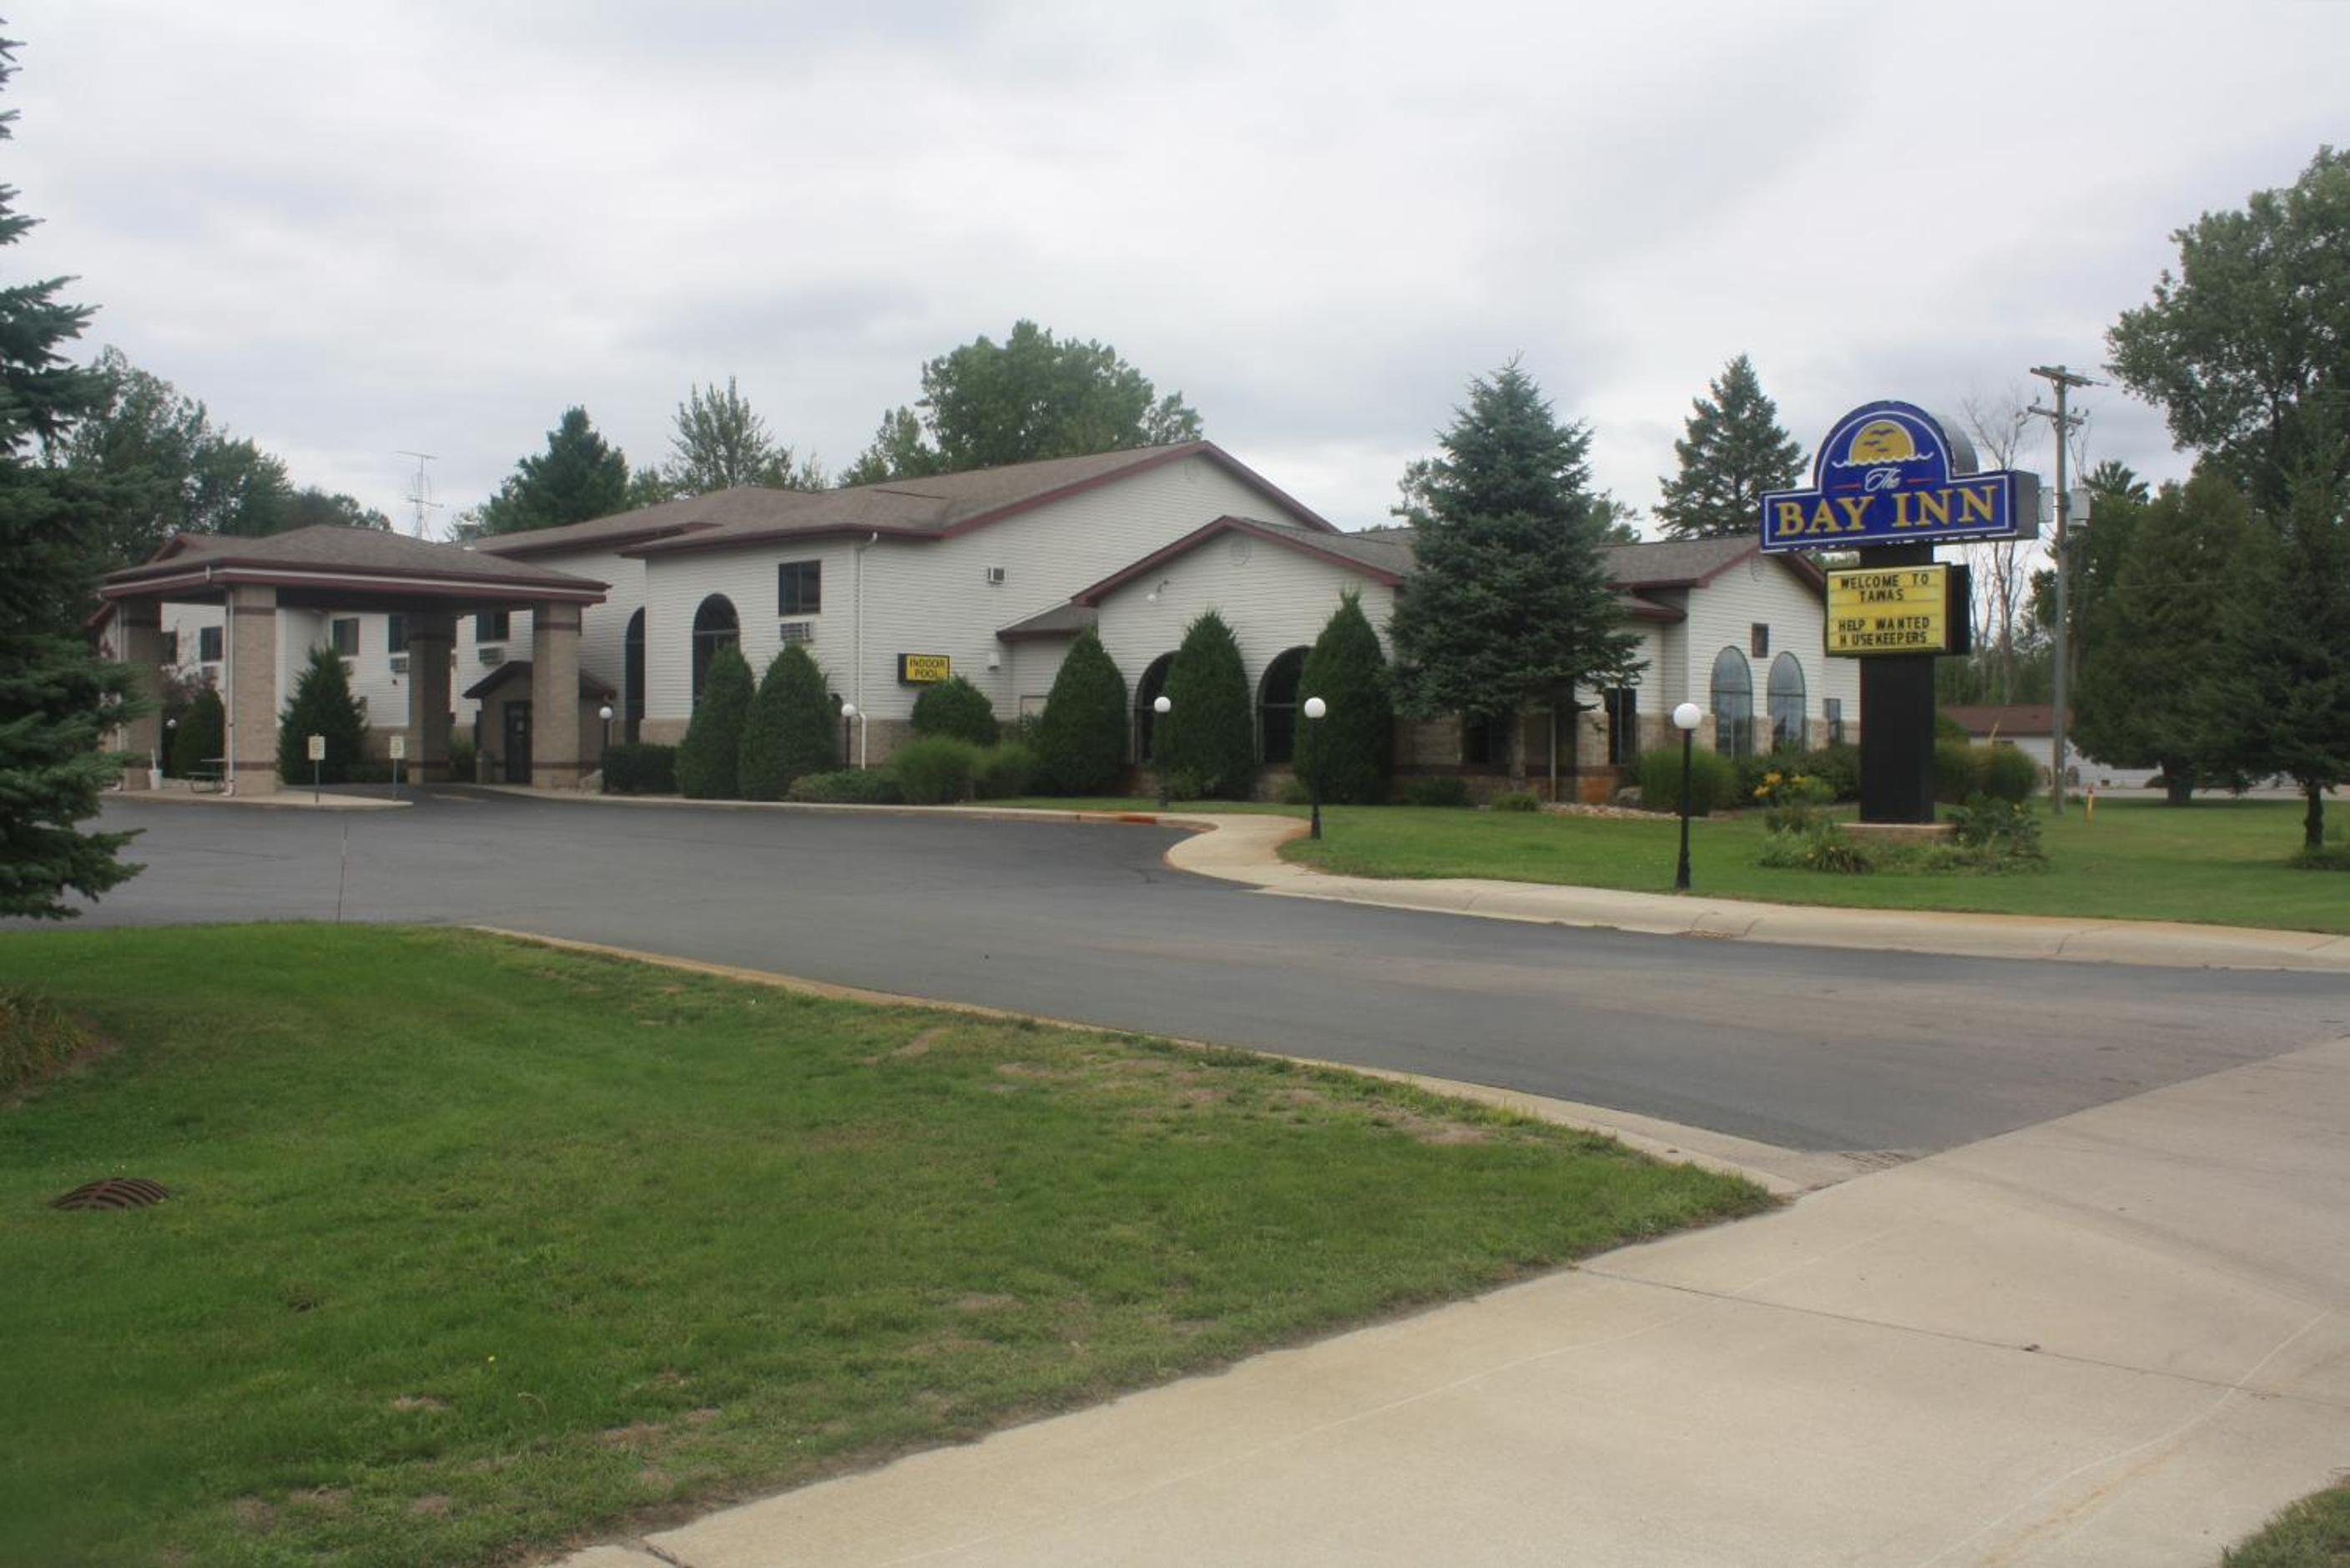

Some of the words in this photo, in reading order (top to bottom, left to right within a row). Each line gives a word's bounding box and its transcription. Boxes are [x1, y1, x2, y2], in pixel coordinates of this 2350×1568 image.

[1864, 467, 1902, 492] The
[1774, 497, 1874, 537] BAY
[1892, 485, 1998, 528] INN
[1841, 574, 1899, 589] WELCOME
[1912, 573, 1929, 586] TO
[1859, 589, 1904, 603] TAWAS
[1838, 619, 1866, 632] HELP
[1875, 617, 1929, 631] WANTED
[909, 658, 946, 668] INDOOR
[914, 668, 941, 679] POOL
